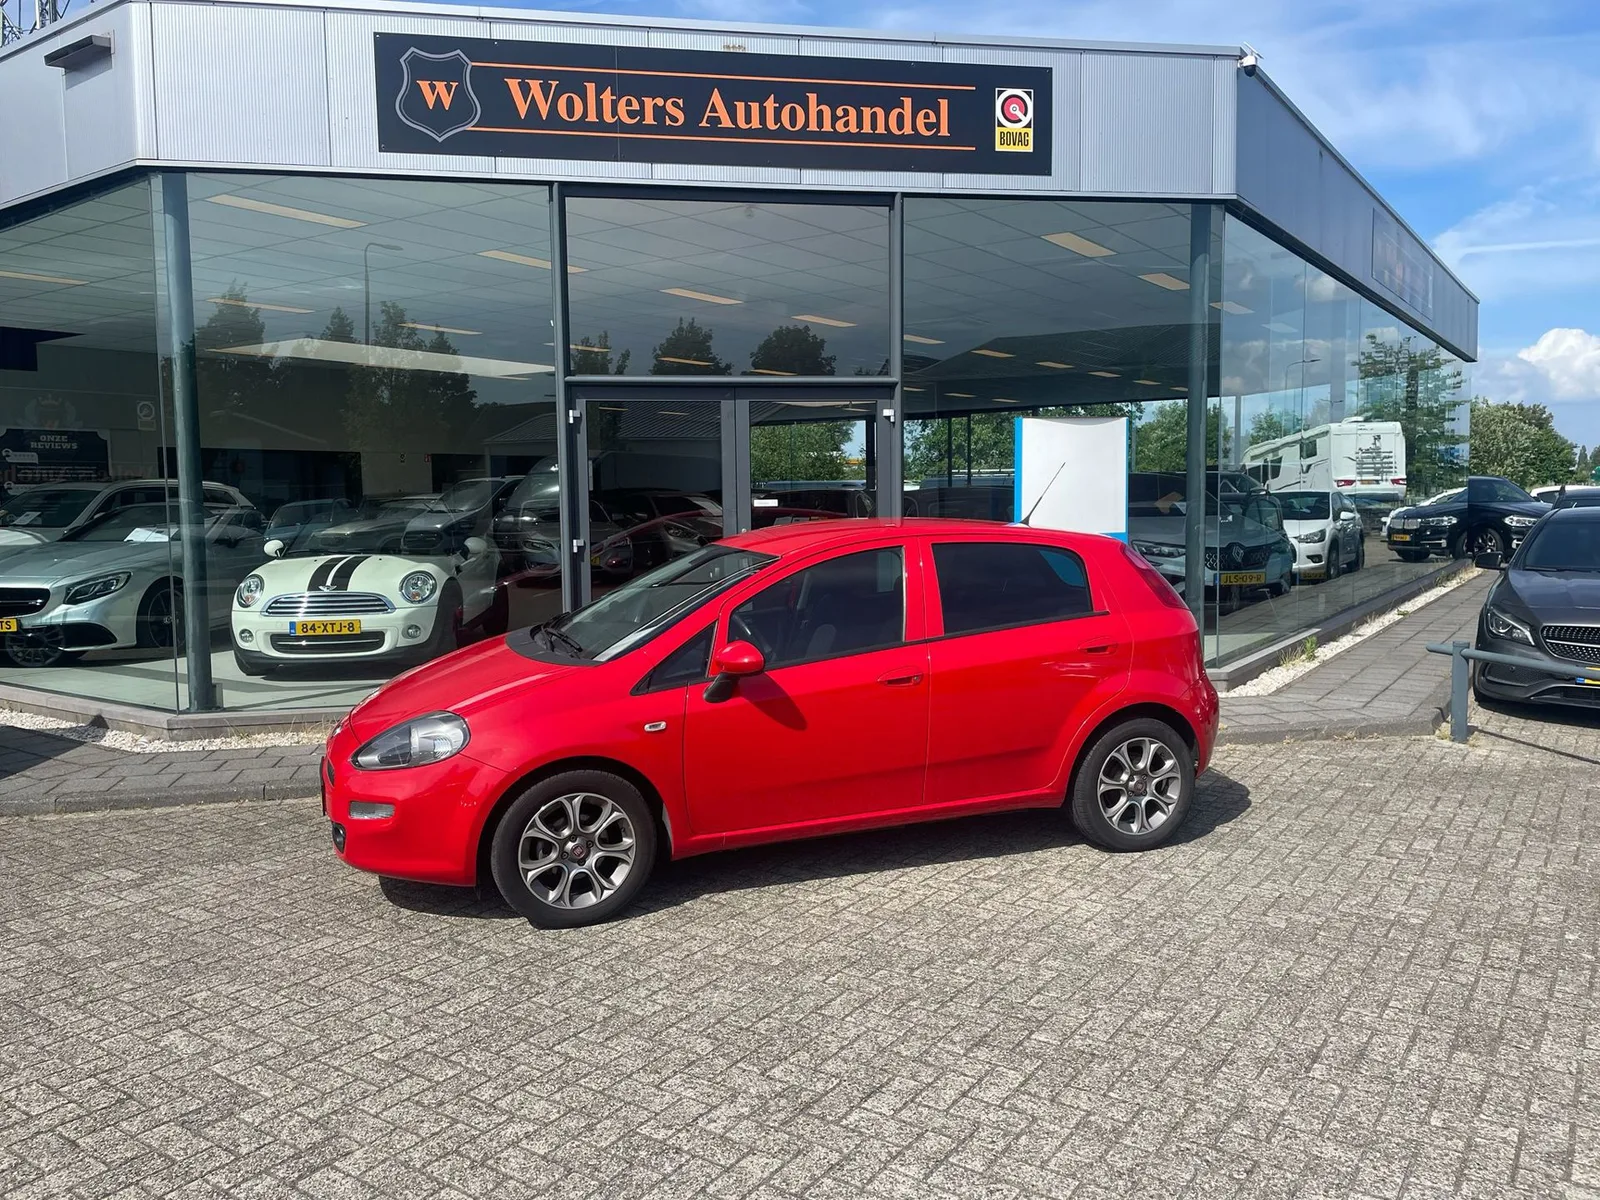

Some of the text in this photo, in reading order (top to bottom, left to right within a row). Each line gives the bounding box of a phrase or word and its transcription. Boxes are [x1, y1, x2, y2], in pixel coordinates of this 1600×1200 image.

[416, 79, 459, 111] W
[504, 78, 951, 137] Wolters Autohandel
[999, 131, 1030, 148] BOVAG
[30, 442, 79, 450] REVIEWS
[1223, 574, 1262, 584] JLS-09-R
[301, 621, 355, 634] 84-XTJ-8
